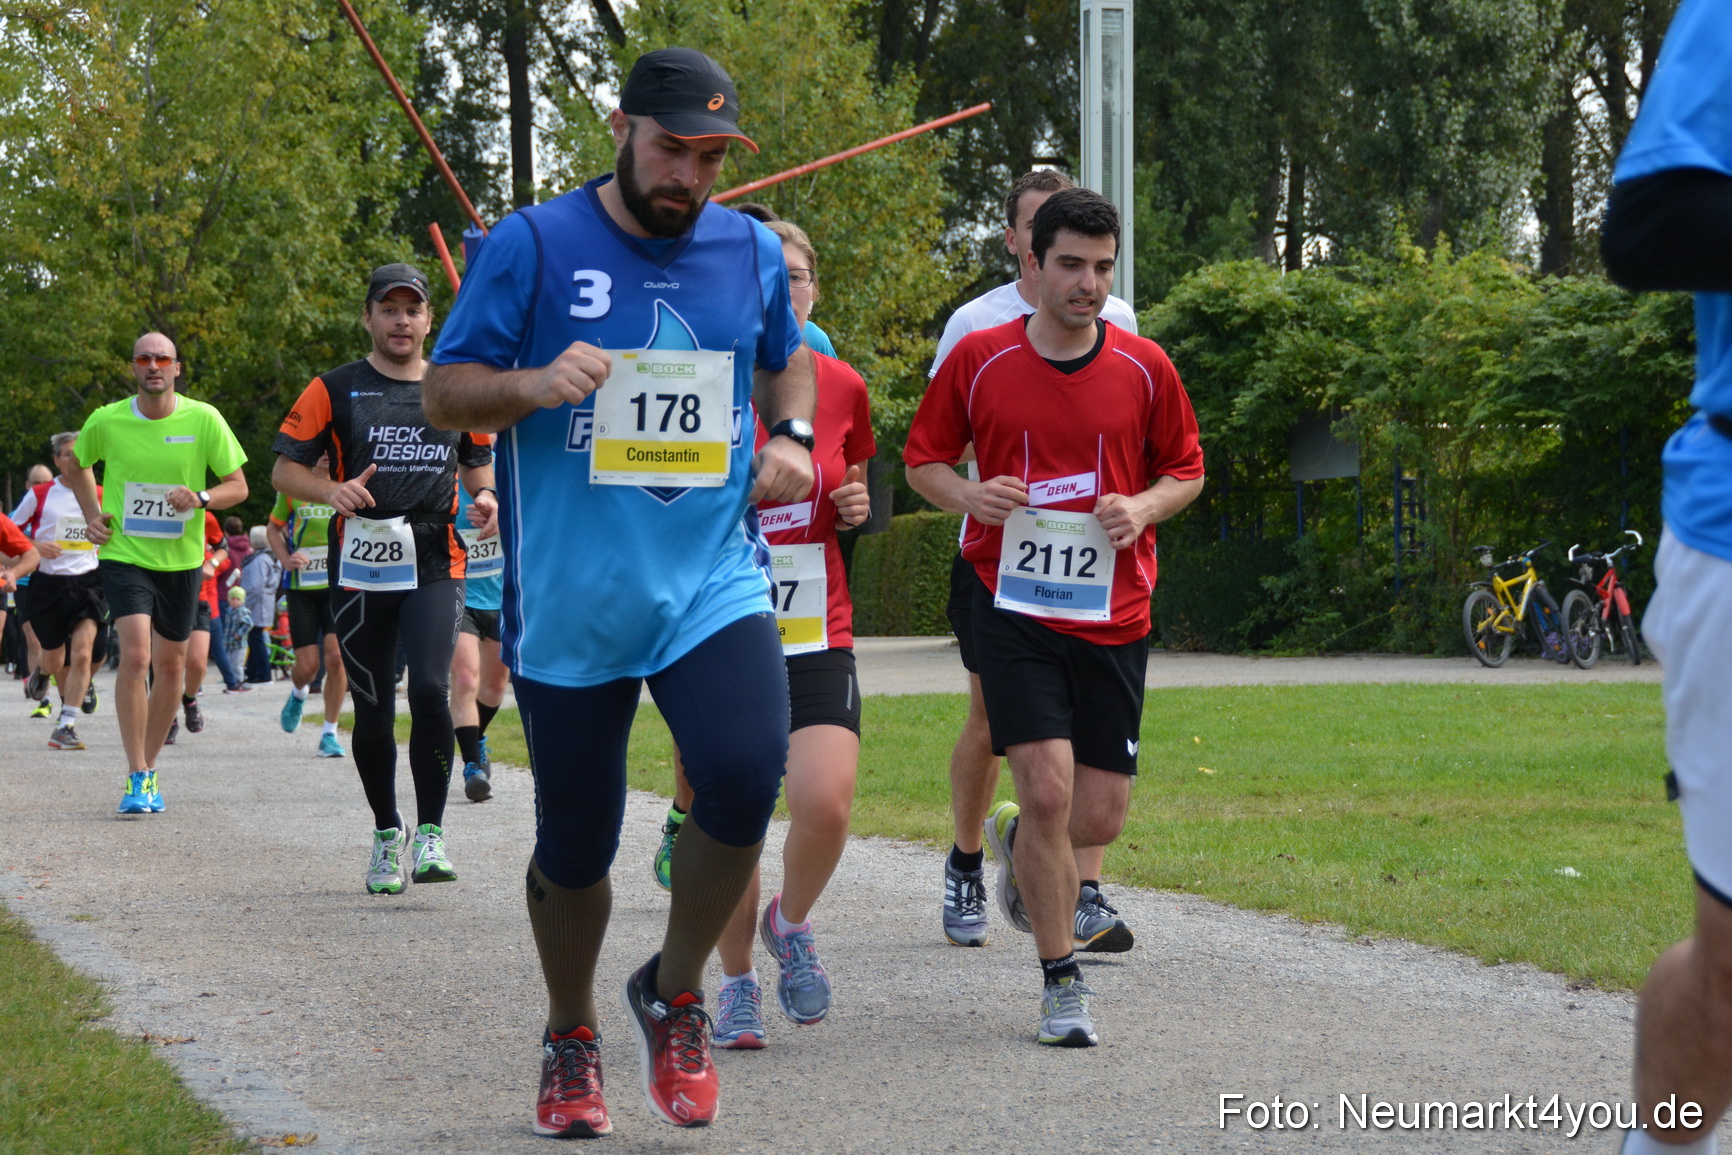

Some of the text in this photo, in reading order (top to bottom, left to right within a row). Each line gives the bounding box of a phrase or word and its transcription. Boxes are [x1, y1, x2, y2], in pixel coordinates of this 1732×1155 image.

[570, 269, 612, 319] 3
[651, 363, 696, 376] BOCK
[630, 392, 702, 434] 178
[368, 426, 425, 442] HECK
[373, 444, 451, 461] DESIGN
[626, 446, 700, 464] Constantin
[1046, 482, 1078, 497] DEHN
[133, 499, 175, 517] 2713
[761, 512, 793, 527] DEHN
[1046, 521, 1086, 531] BOCK
[350, 537, 403, 562] 2228
[1016, 540, 1097, 578] 2112
[369, 569, 380, 578] Uli
[1035, 585, 1073, 601] Florian
